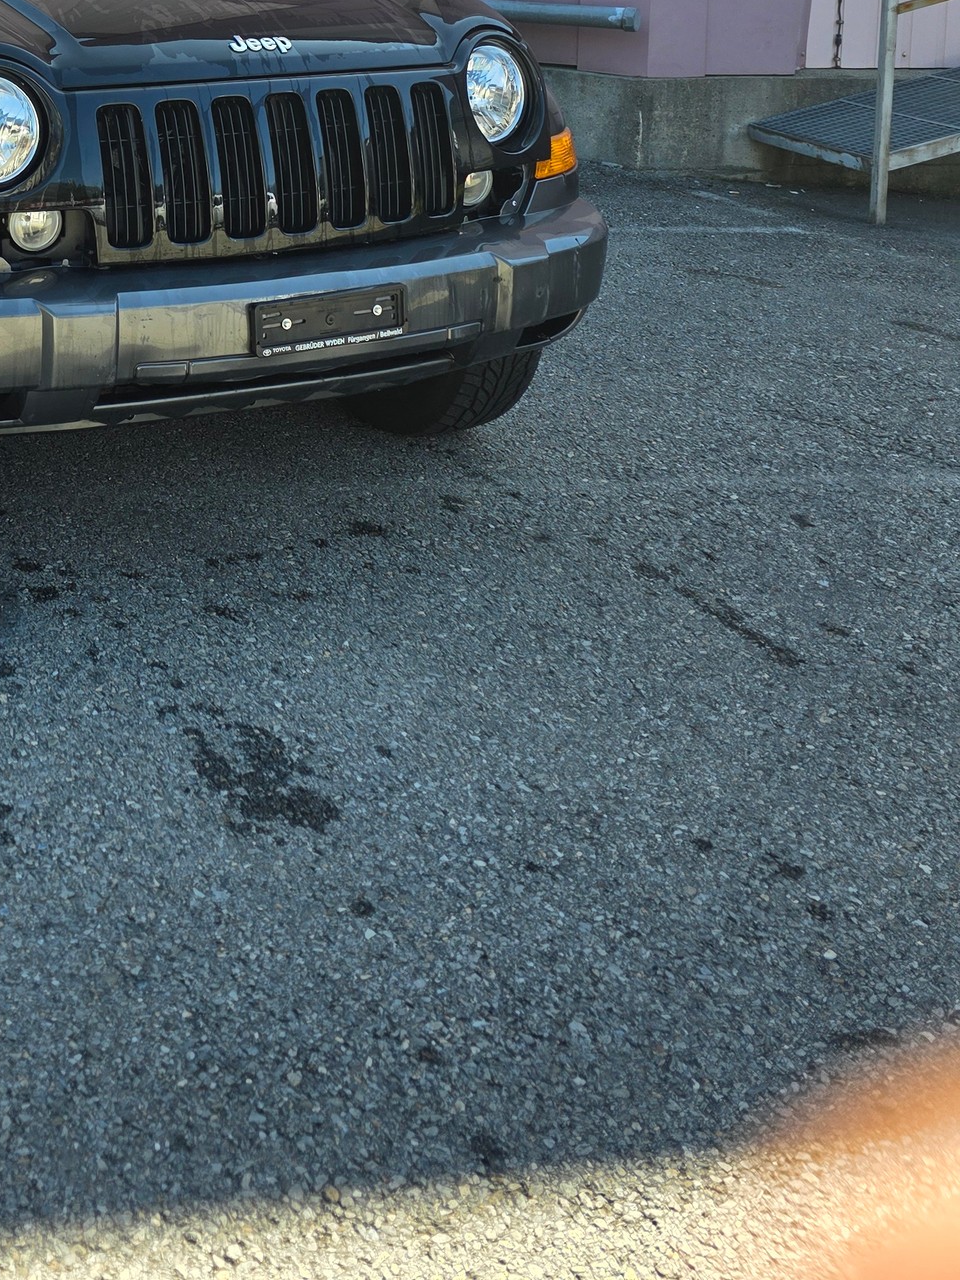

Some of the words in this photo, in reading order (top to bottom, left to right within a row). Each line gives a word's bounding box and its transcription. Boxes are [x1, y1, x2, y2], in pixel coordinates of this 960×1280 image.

[229, 35, 292, 54] Jeep
[295, 341, 324, 351] GEBRÜDER
[325, 337, 345, 346] WYDEN
